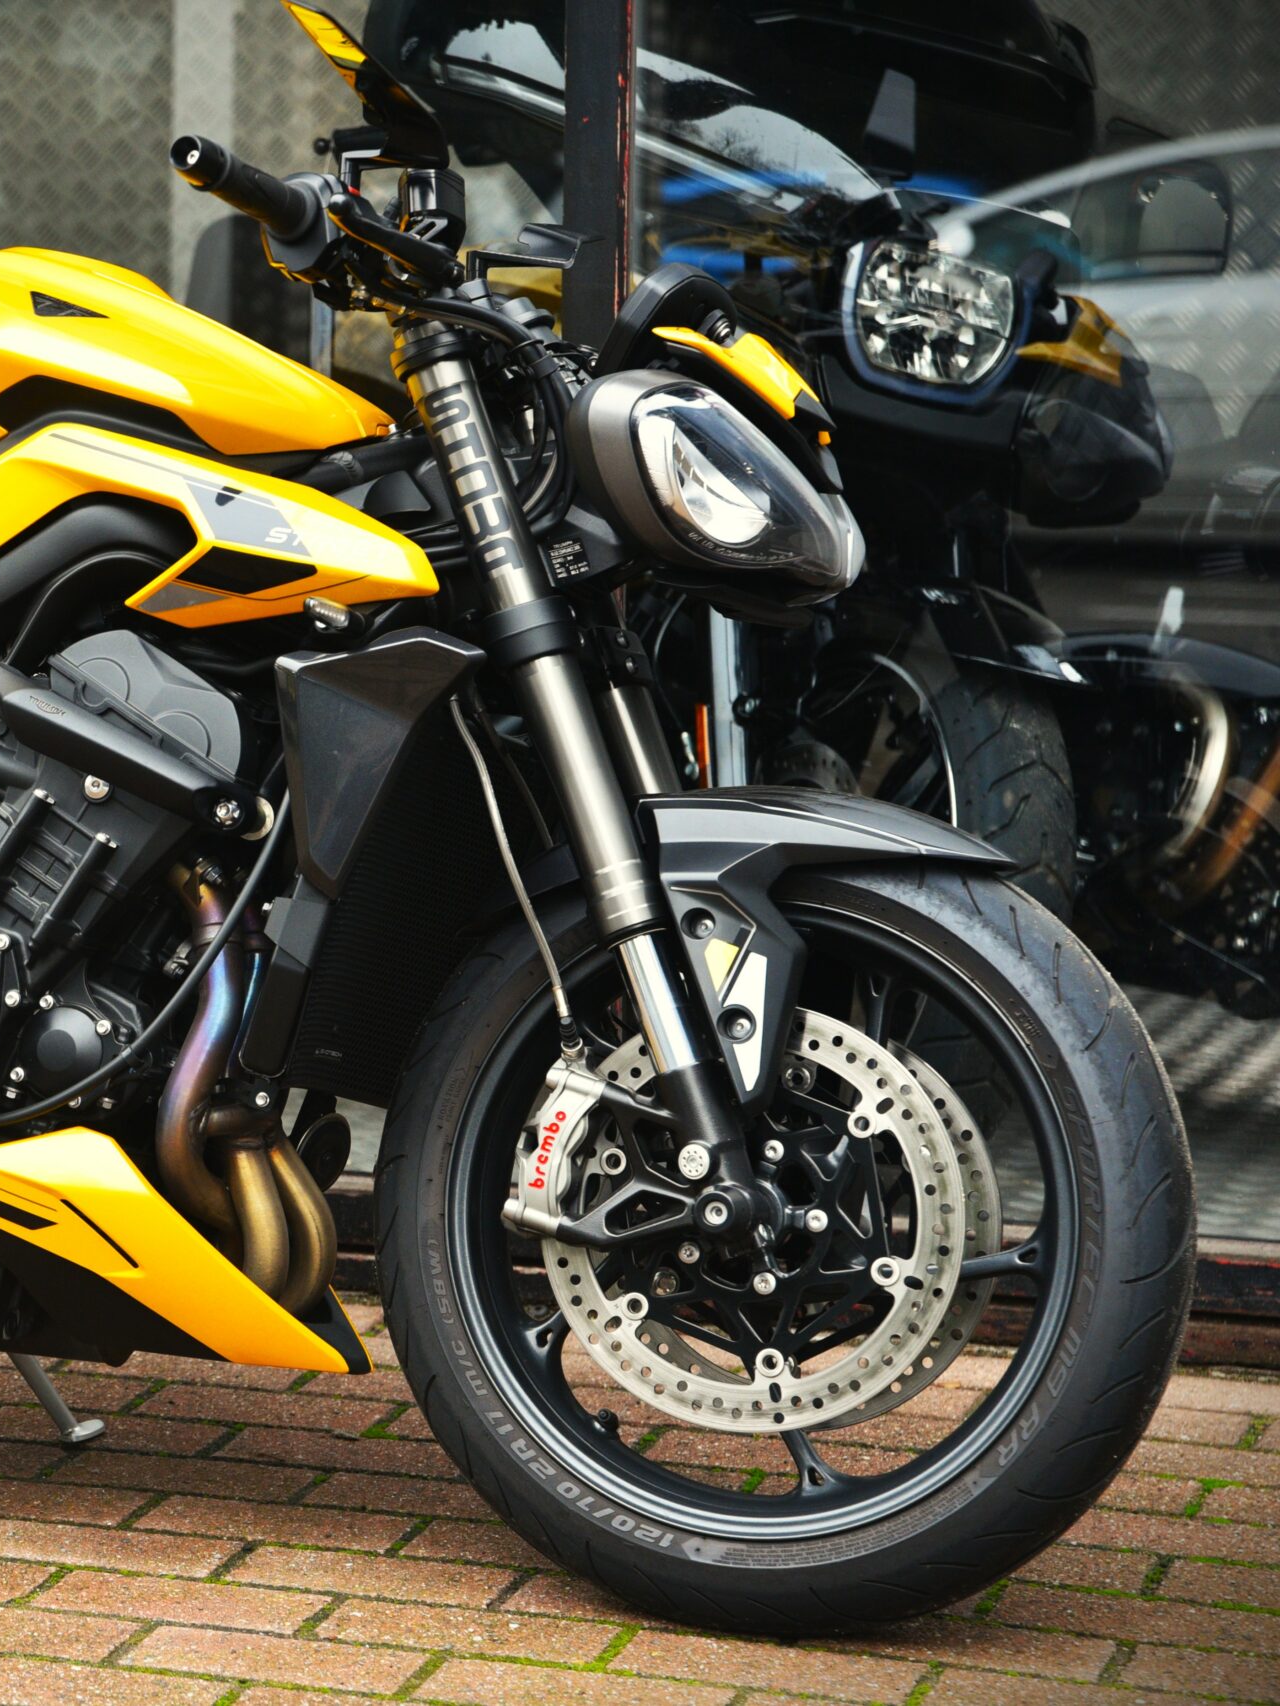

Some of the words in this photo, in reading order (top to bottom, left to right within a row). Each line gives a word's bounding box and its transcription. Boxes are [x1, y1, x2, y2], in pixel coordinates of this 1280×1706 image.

[528, 1111, 566, 1189] brembo
[427, 1239, 454, 1325] (58W)
[556, 1481, 674, 1548] 120/70
